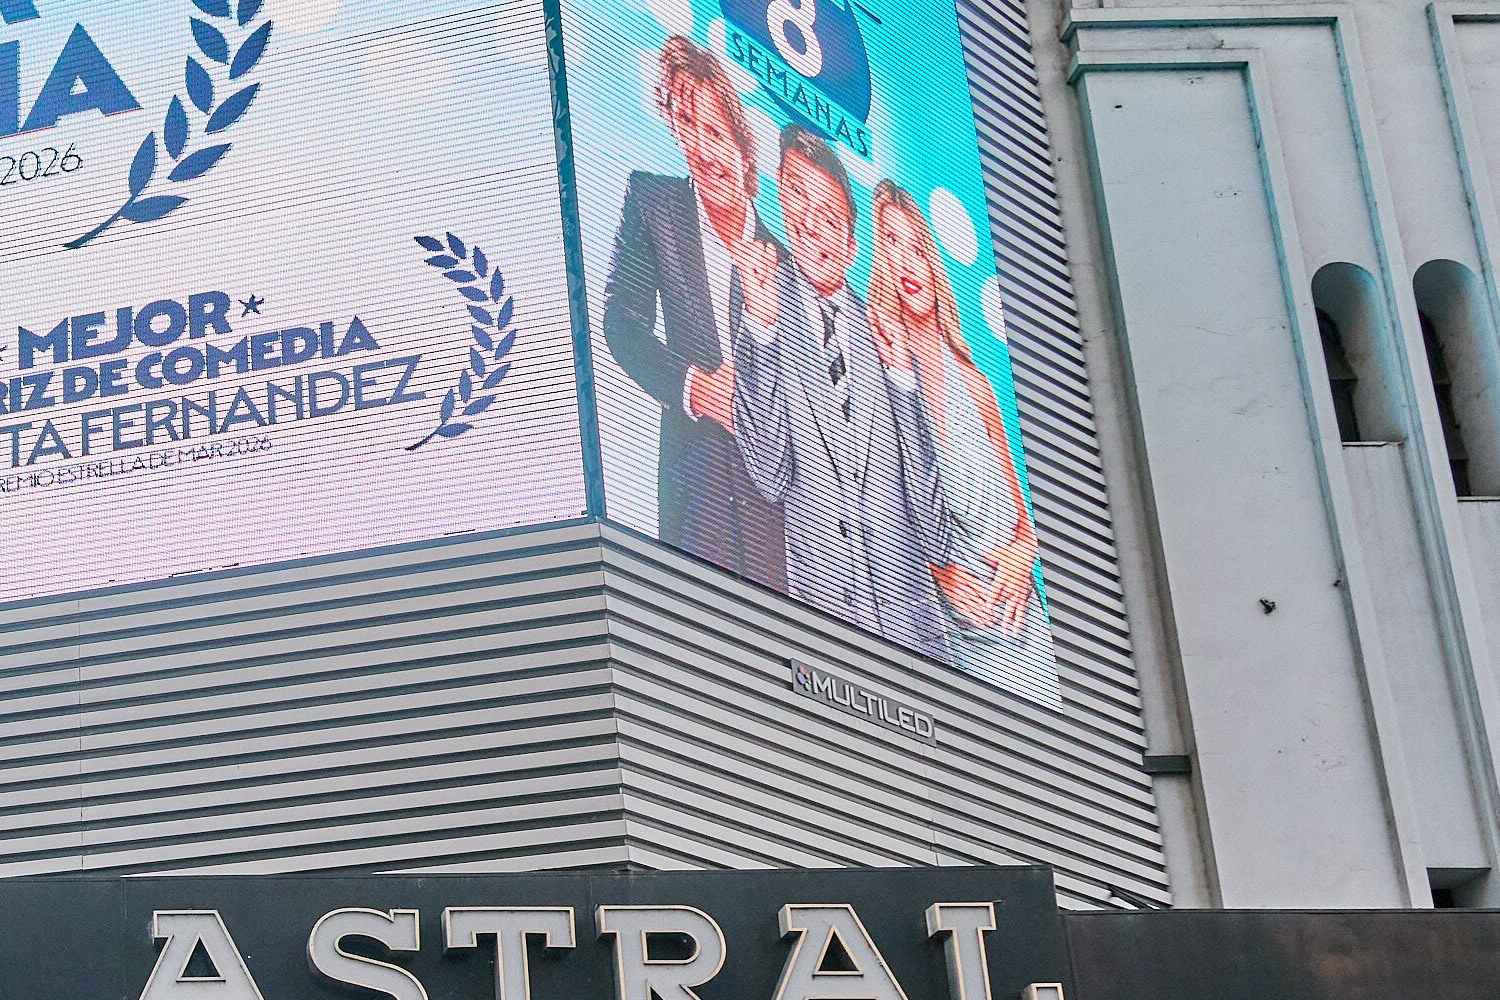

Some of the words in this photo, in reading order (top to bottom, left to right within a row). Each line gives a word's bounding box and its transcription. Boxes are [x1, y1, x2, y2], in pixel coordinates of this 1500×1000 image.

[732, 32, 868, 157] SEMANAS
[0, 143, 84, 187] 2026
[18, 290, 233, 370] MEJOR
[63, 358, 129, 403] DE
[135, 315, 381, 392] COMEDIA
[81, 353, 428, 457] FERNANDEZ
[57, 455, 146, 484] ESTRELLA
[178, 443, 224, 464] MAR
[225, 435, 274, 456] 2026
[811, 670, 933, 738] MULTILED
